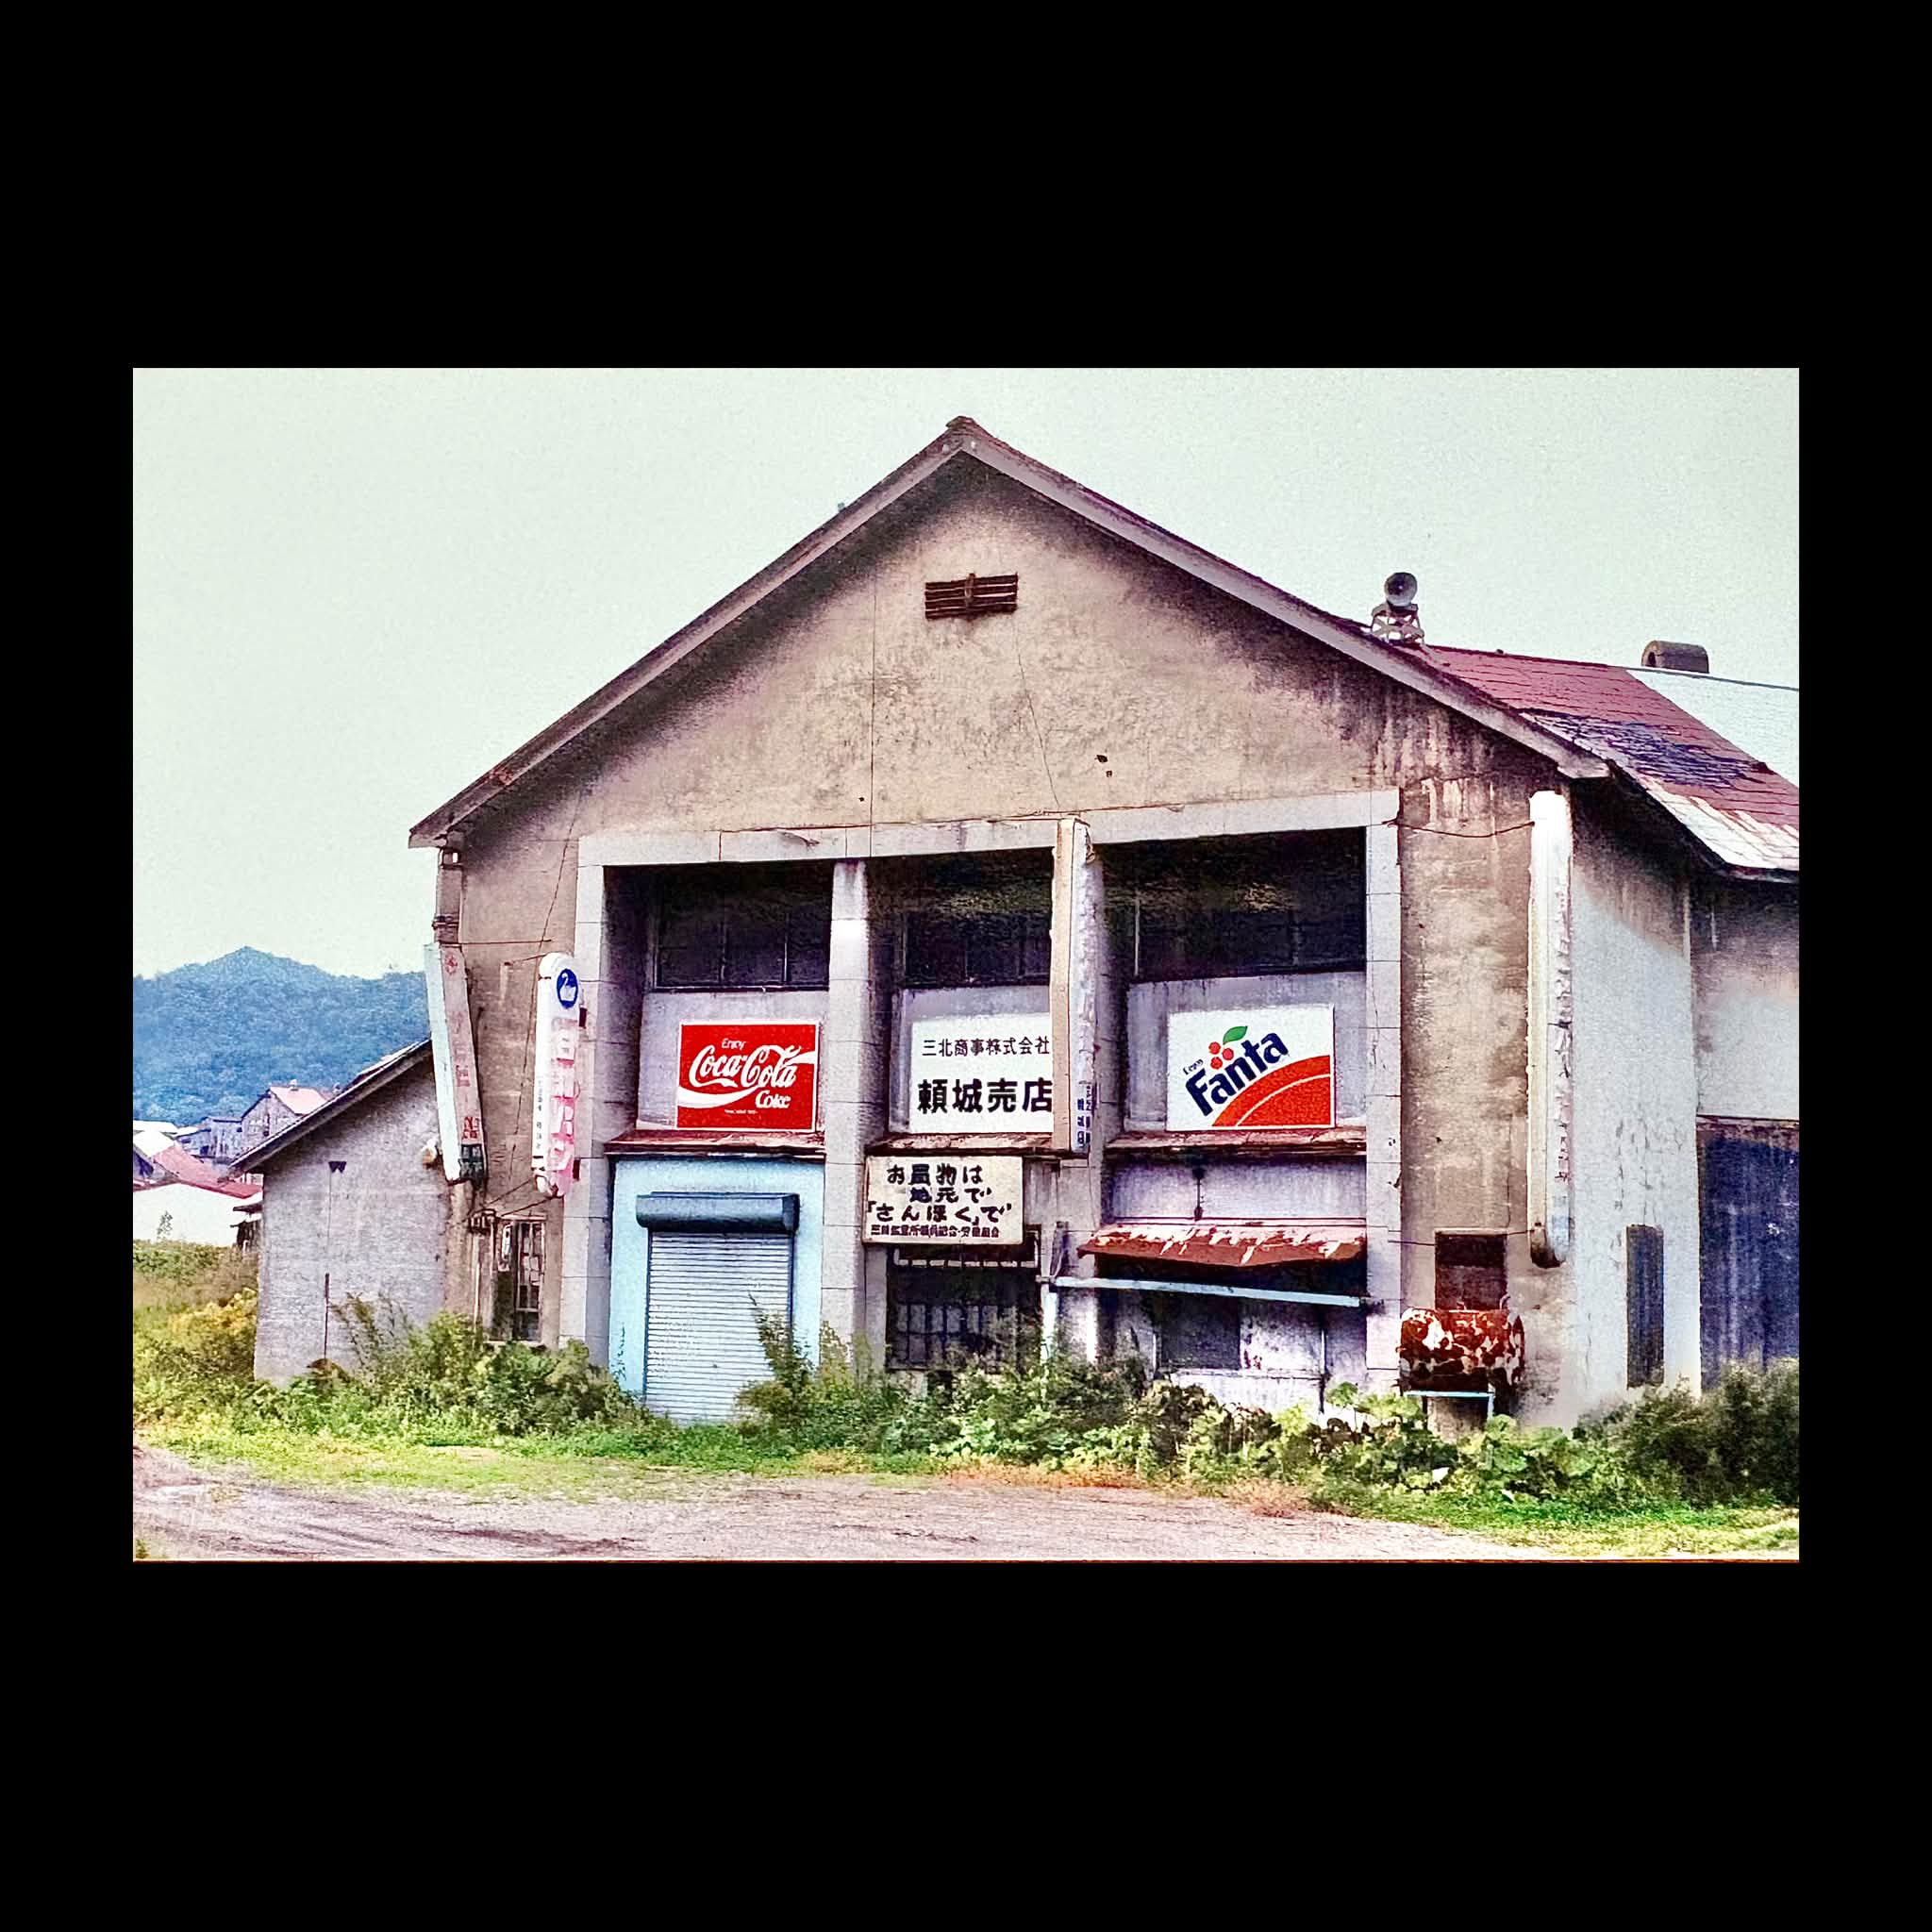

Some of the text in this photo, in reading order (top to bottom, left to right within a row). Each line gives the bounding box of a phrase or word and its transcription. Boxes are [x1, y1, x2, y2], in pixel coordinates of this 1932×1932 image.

[922, 1036, 1051, 1058] 三北商事株式会社
[1186, 1032, 1289, 1117] Fanta
[755, 1090, 791, 1108] Coke
[917, 1077, 1053, 1114] 頼城売店
